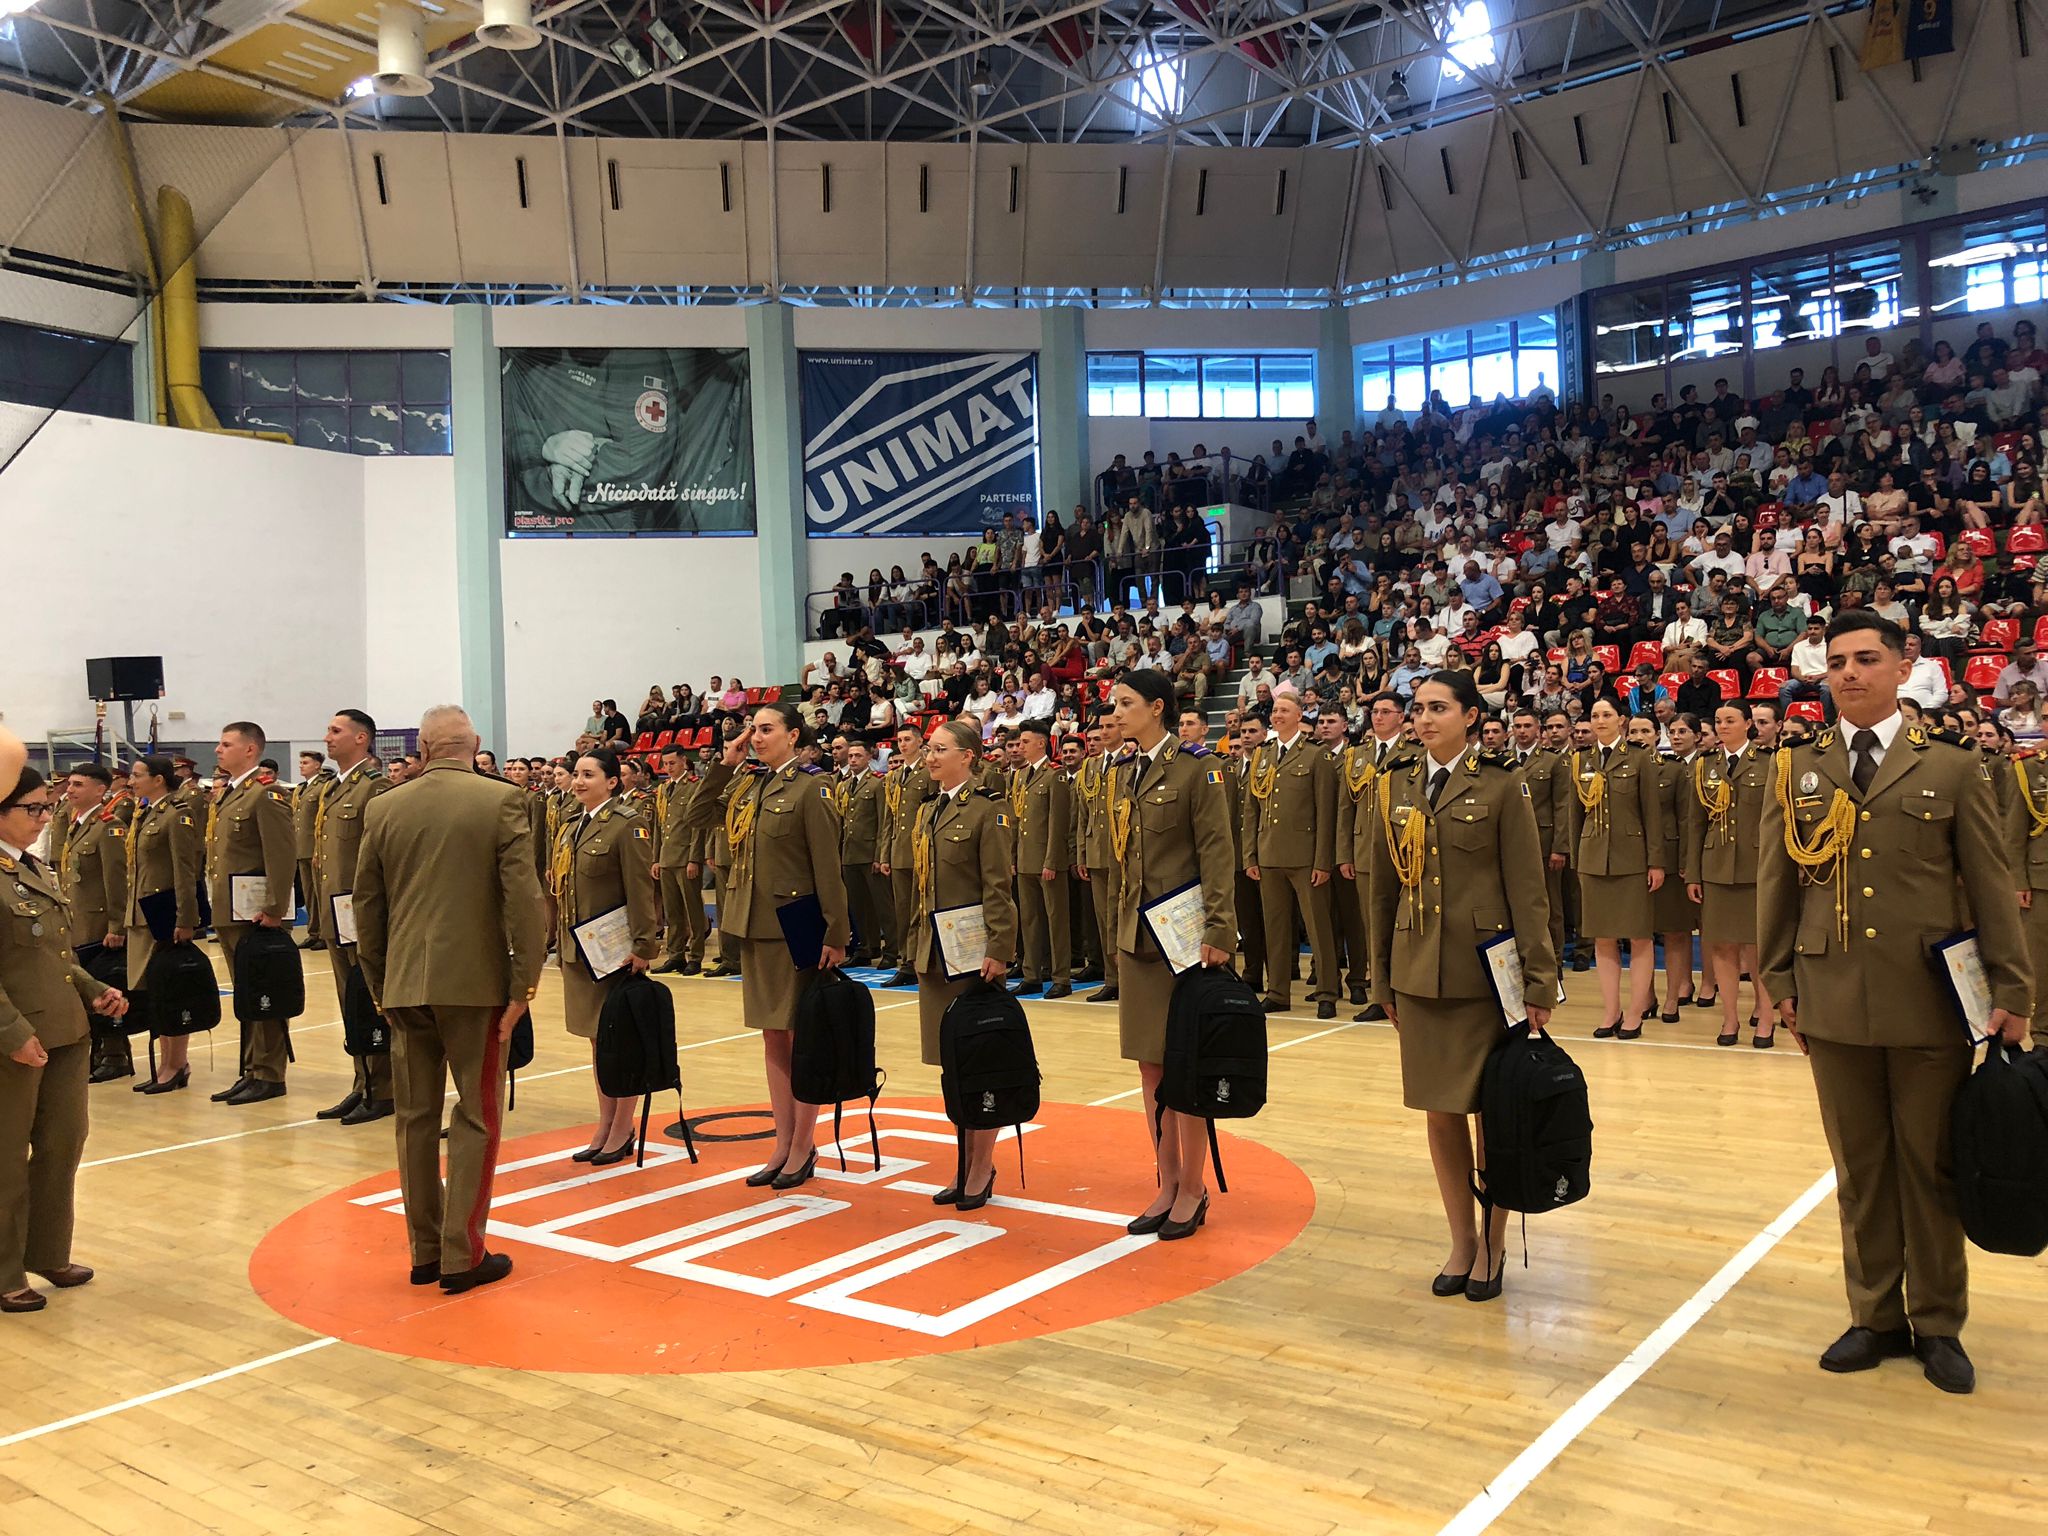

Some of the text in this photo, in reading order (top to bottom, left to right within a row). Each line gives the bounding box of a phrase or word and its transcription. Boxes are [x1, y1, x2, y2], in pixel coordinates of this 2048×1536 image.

[1923, 0, 1937, 20] 9
[807, 356, 874, 366] www.unimat.ro
[806, 368, 1033, 524] UNIMAT
[587, 482, 747, 506] Niciodată singur!
[980, 493, 1032, 503] PARTENER
[514, 515, 552, 527] plastic
[554, 516, 576, 527] pro
